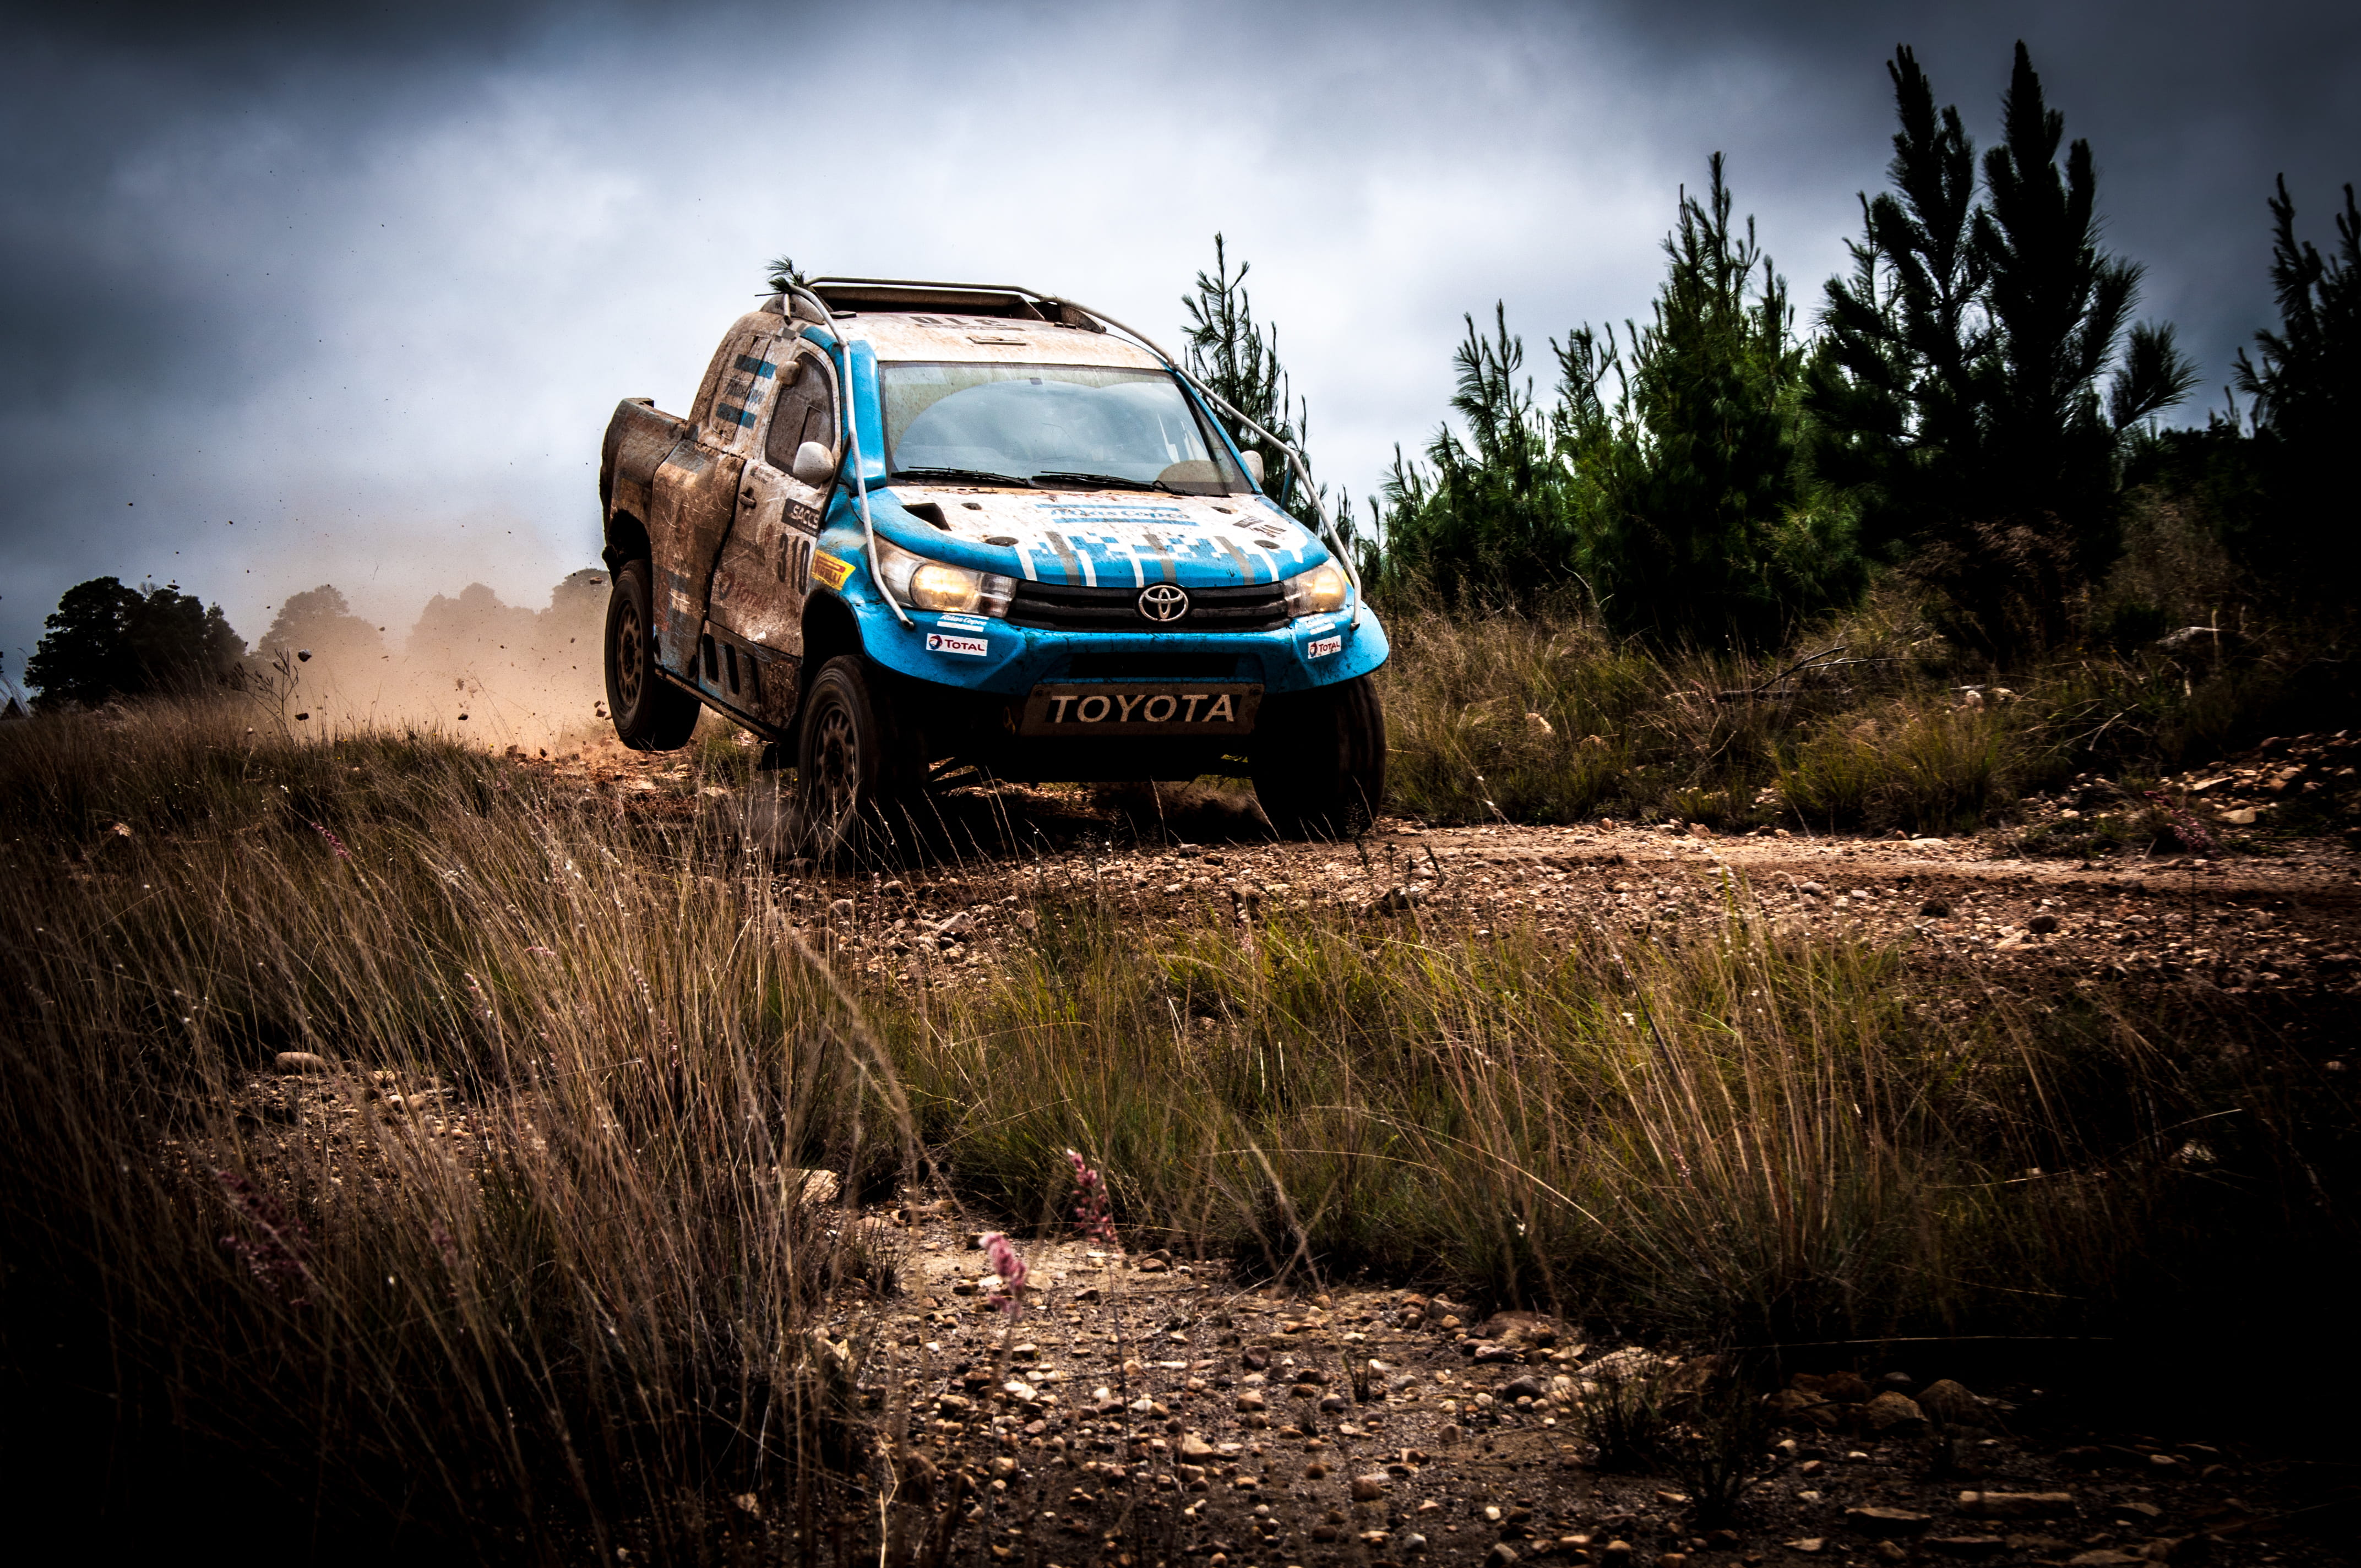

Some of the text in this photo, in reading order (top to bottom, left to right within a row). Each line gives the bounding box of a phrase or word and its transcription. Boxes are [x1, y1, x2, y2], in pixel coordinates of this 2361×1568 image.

[1051, 508, 1190, 519] Atlas Copco
[777, 533, 810, 596] 310
[944, 639, 985, 651] TOTAL
[1319, 641, 1340, 652] TOTAL
[1051, 694, 1234, 723] TOYOTA
